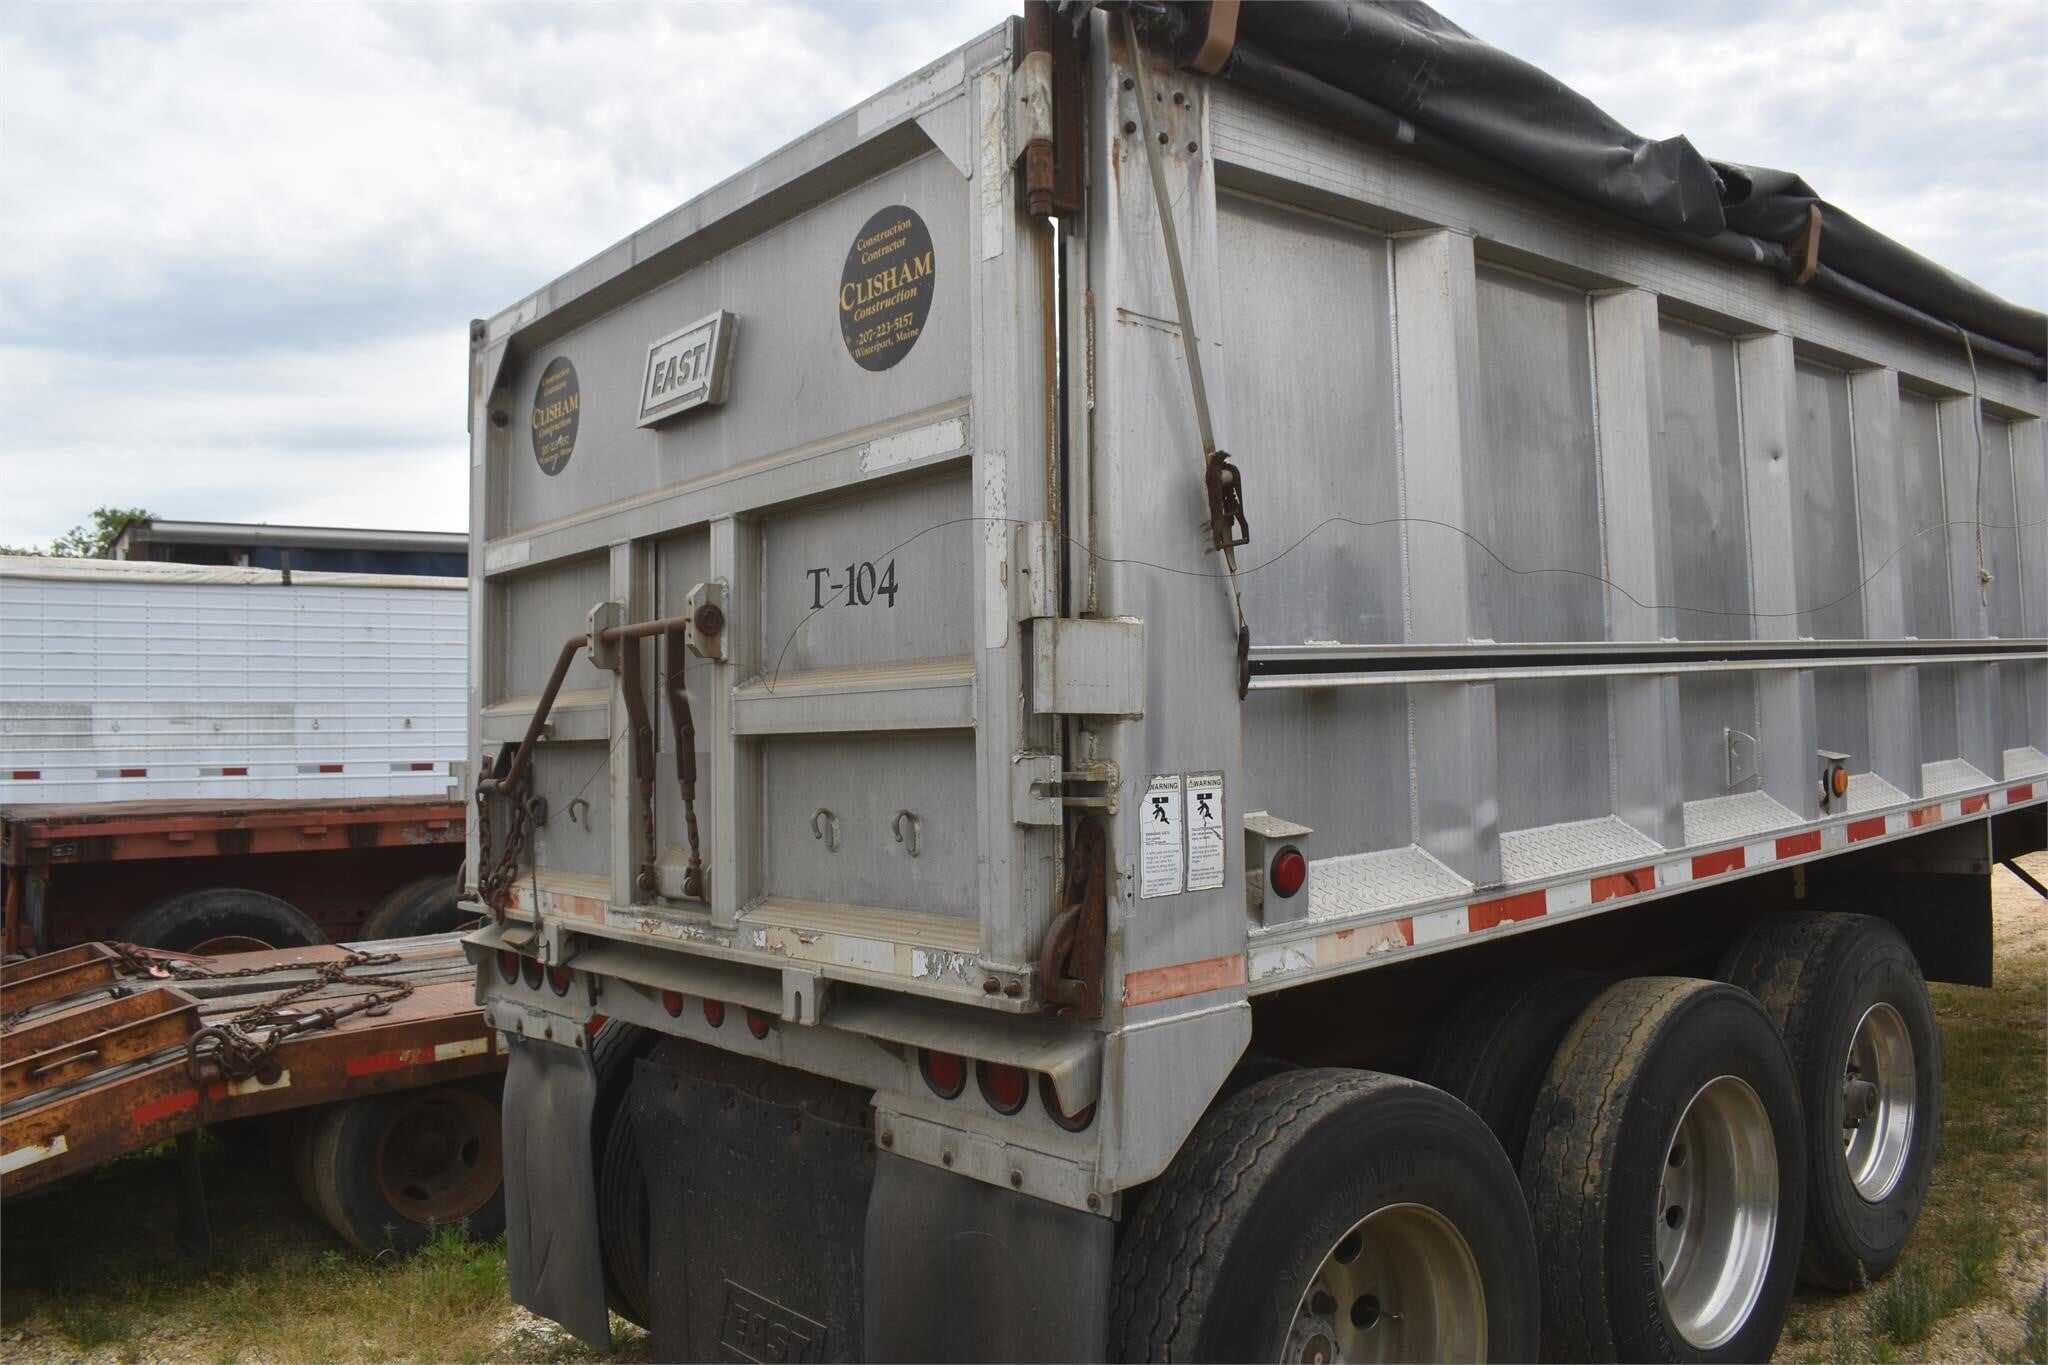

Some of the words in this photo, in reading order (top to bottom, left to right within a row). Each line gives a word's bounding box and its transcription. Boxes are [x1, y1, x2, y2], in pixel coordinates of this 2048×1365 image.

[856, 217, 912, 251] Construction
[861, 236, 907, 265] Contractor
[840, 251, 933, 312] CLISHAM
[853, 287, 917, 322] Construction
[896, 327, 920, 344] Maine
[651, 342, 707, 398] EAST
[806, 558, 899, 610] T-104
[1194, 779, 1222, 787] WARNING
